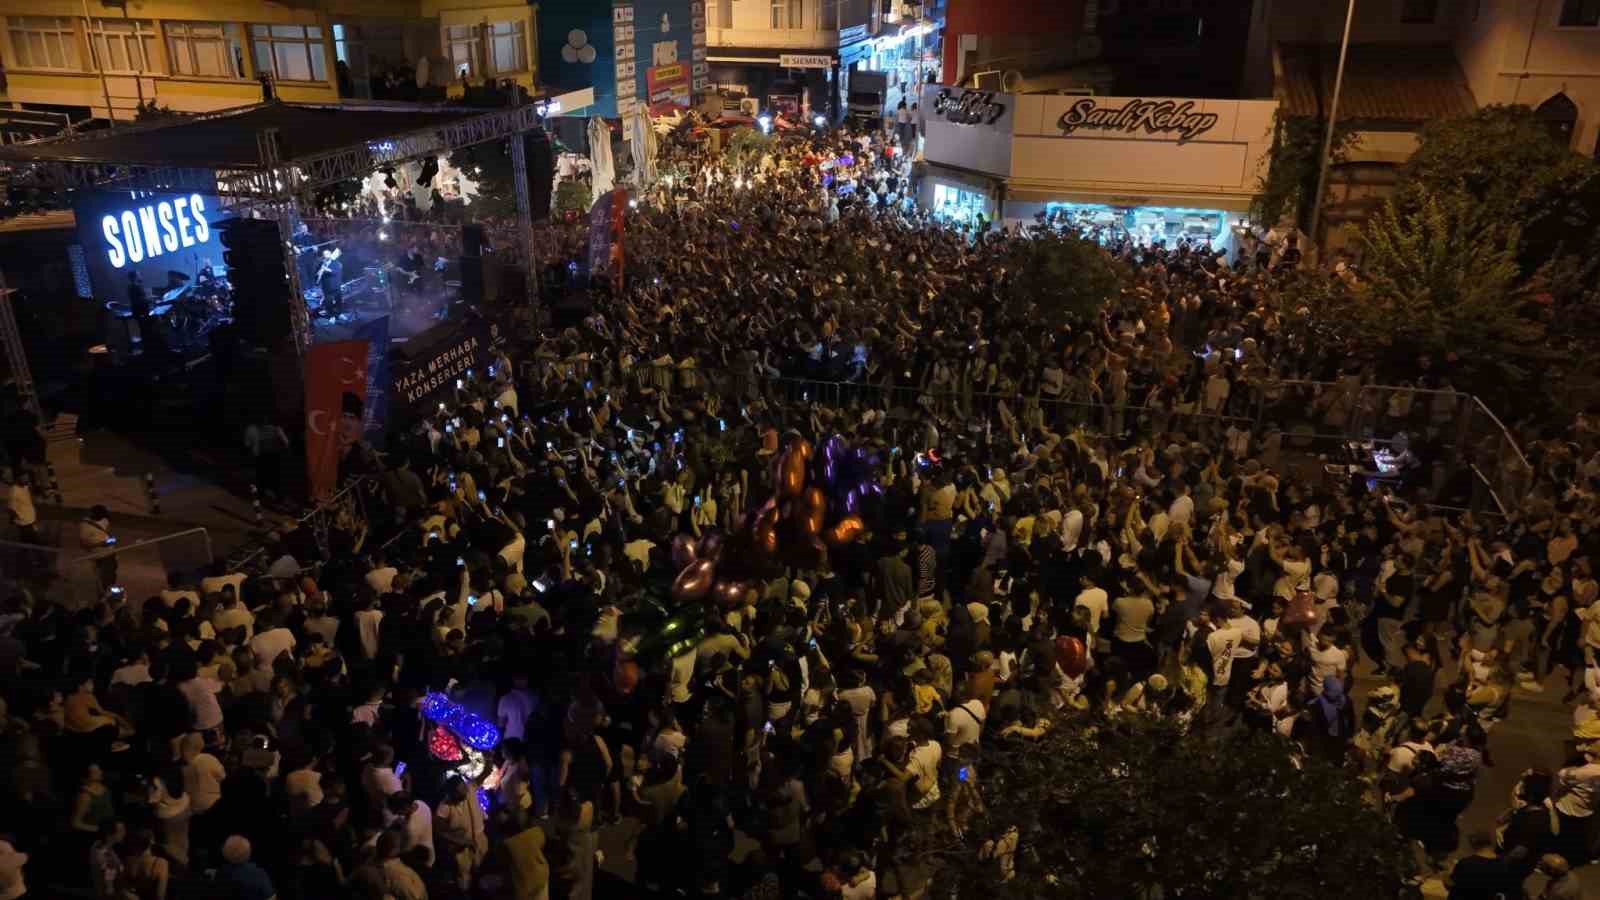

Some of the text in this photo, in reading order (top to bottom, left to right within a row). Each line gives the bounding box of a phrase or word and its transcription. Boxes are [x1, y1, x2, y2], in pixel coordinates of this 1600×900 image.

[791, 56, 829, 65] SIEMENS
[1128, 100, 1218, 142] Kebap
[102, 193, 209, 269] SONSES
[394, 336, 480, 393] YAZA MERHABA
